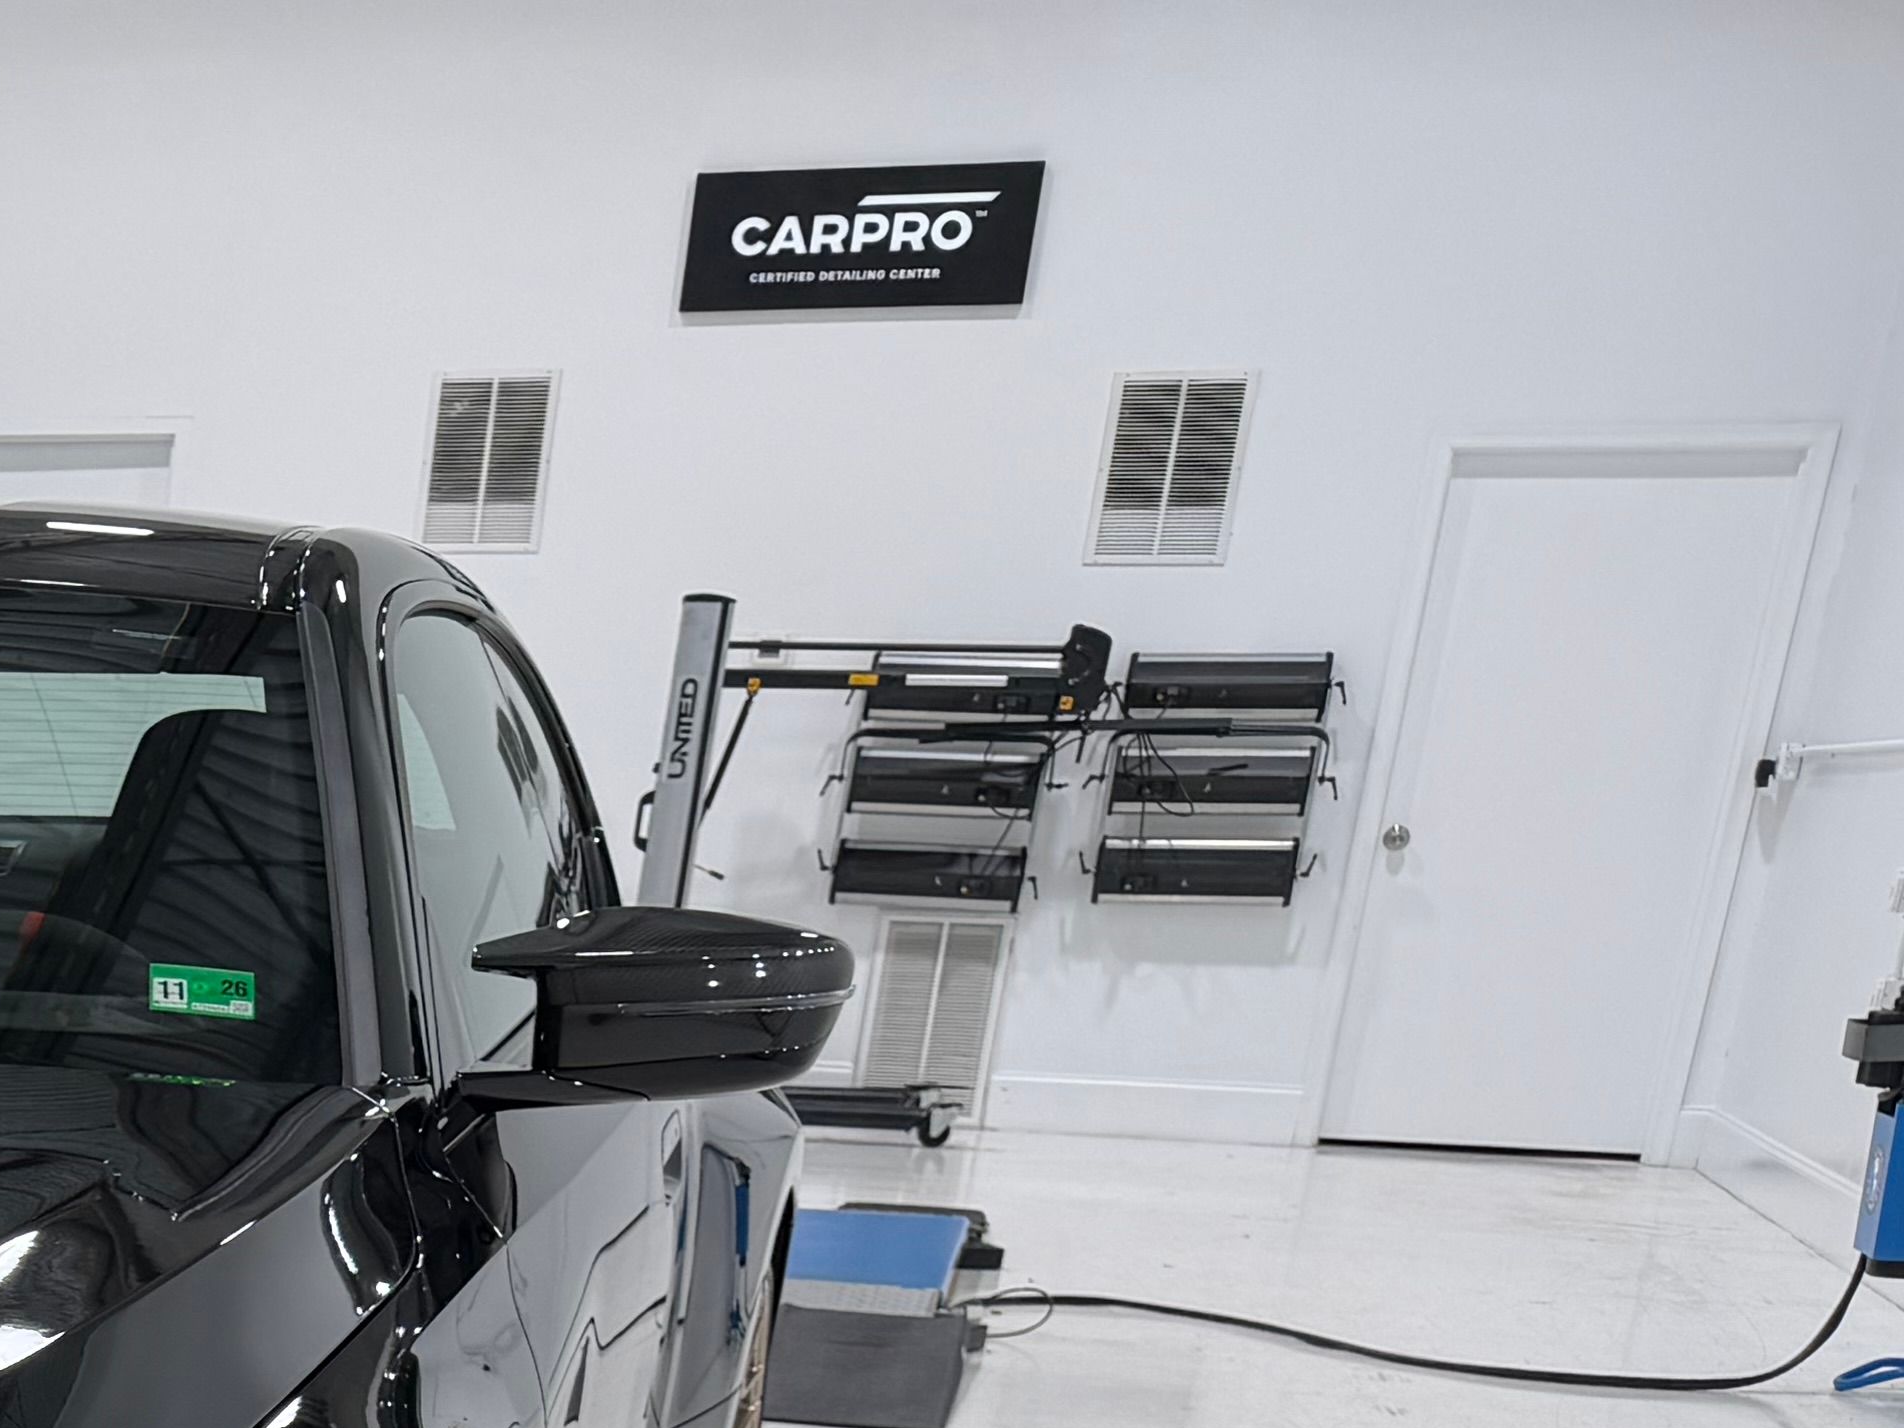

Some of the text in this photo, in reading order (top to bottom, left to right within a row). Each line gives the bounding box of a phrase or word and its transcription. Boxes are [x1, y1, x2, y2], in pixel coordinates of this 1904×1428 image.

[732, 210, 973, 256] CARPRO
[749, 267, 941, 283] CERTIFIED DETAILING CENTER
[667, 678, 698, 778] UNITED
[158, 980, 185, 1000] 11
[221, 979, 248, 998] 26
